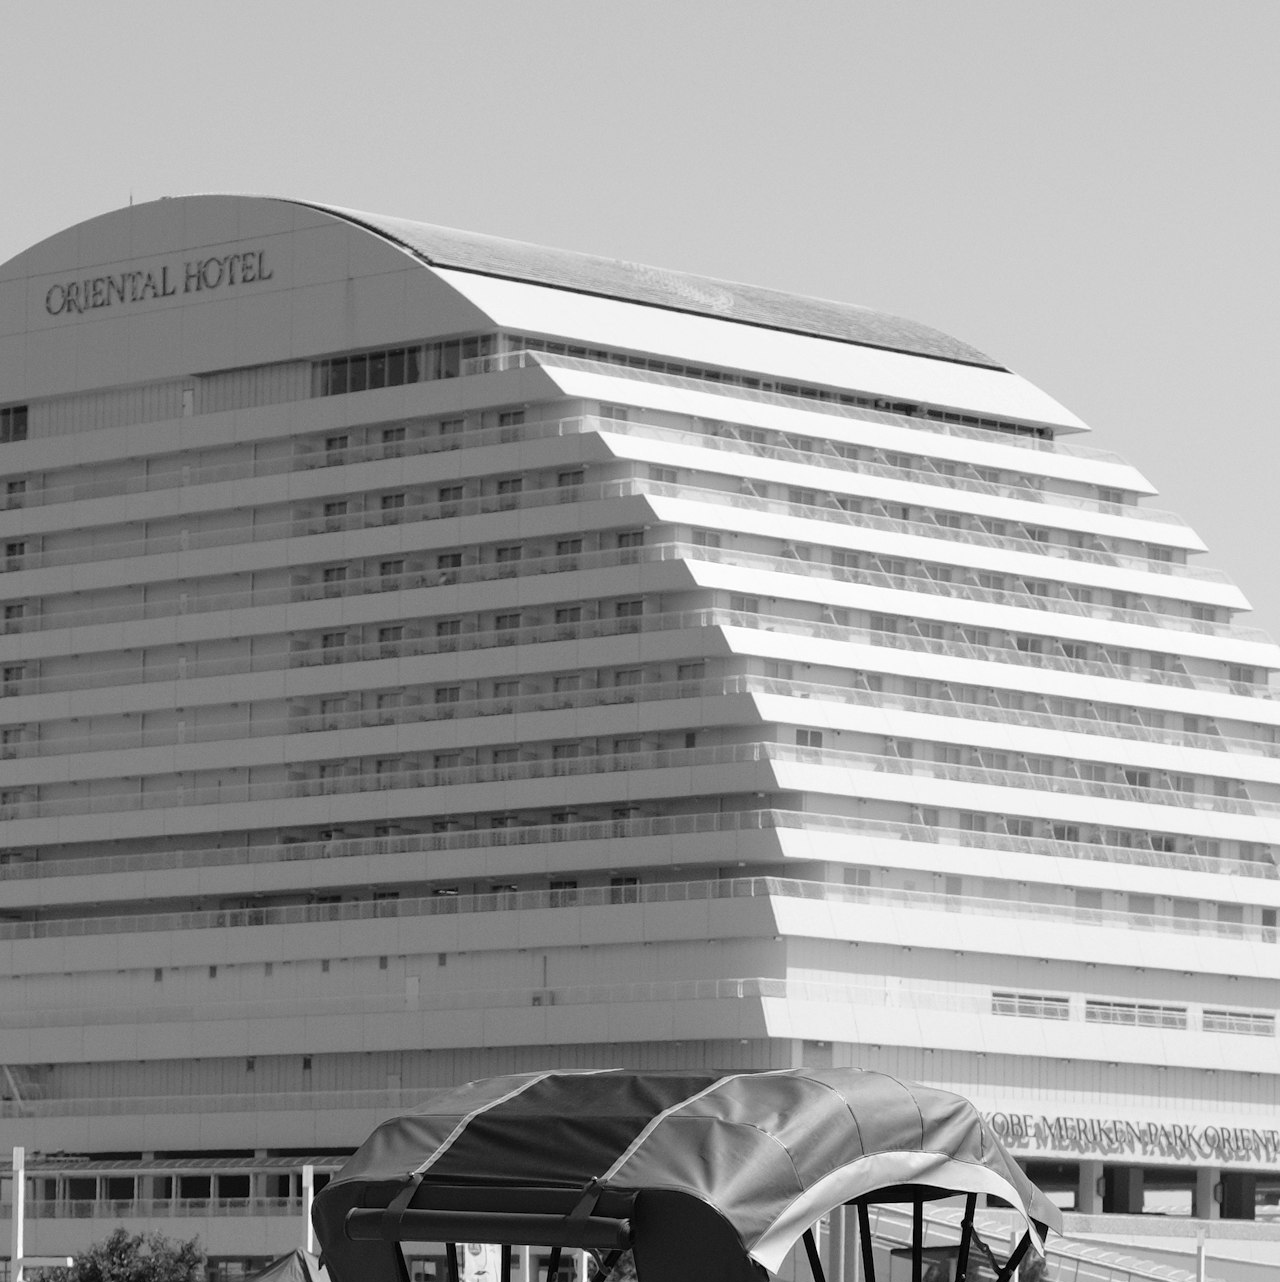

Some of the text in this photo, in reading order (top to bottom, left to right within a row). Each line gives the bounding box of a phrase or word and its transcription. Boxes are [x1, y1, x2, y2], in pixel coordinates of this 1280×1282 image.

[45, 251, 274, 315] ORIENTAL HOTEL
[1040, 1115, 1141, 1145] MERIKEN
[1147, 1122, 1202, 1151] PARK
